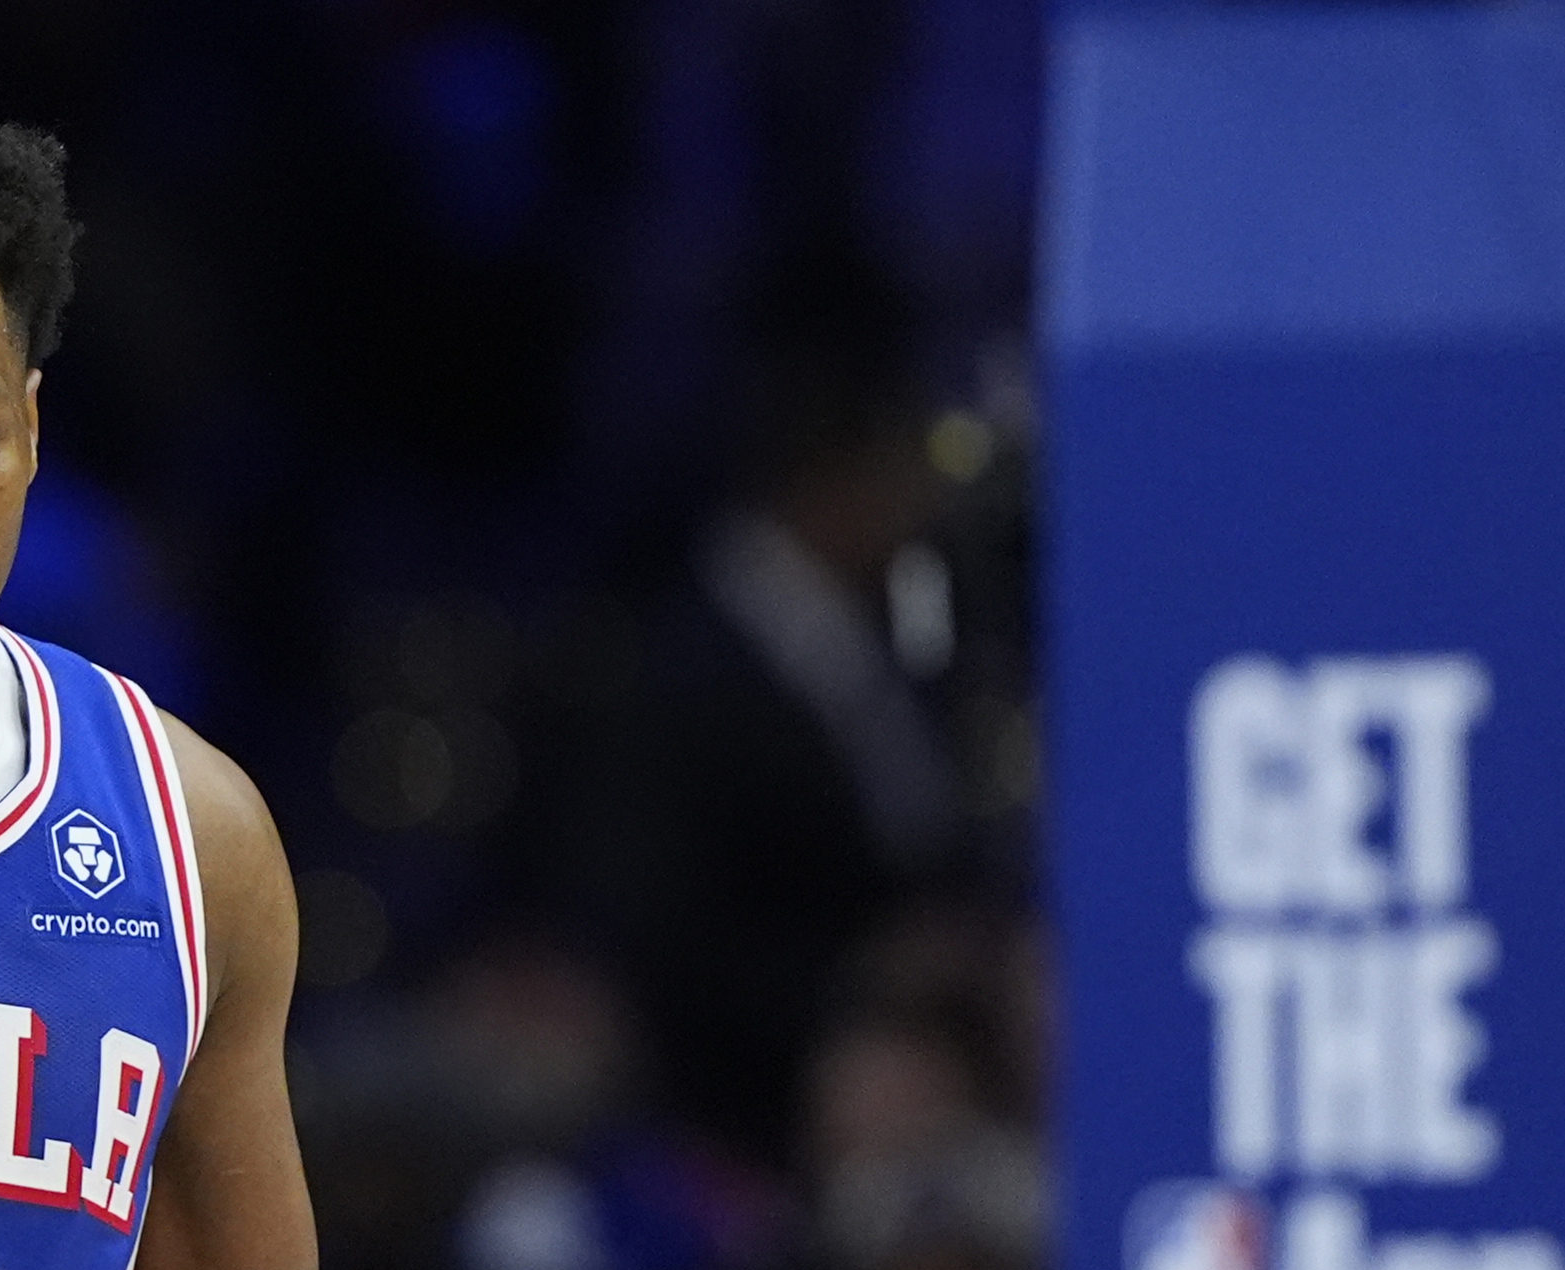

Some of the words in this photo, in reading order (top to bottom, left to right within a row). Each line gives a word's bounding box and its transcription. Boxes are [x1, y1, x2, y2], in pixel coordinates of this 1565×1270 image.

[1190, 654, 1488, 910] GET
[31, 912, 160, 938] crypto.com
[1186, 914, 1502, 1183] THE
